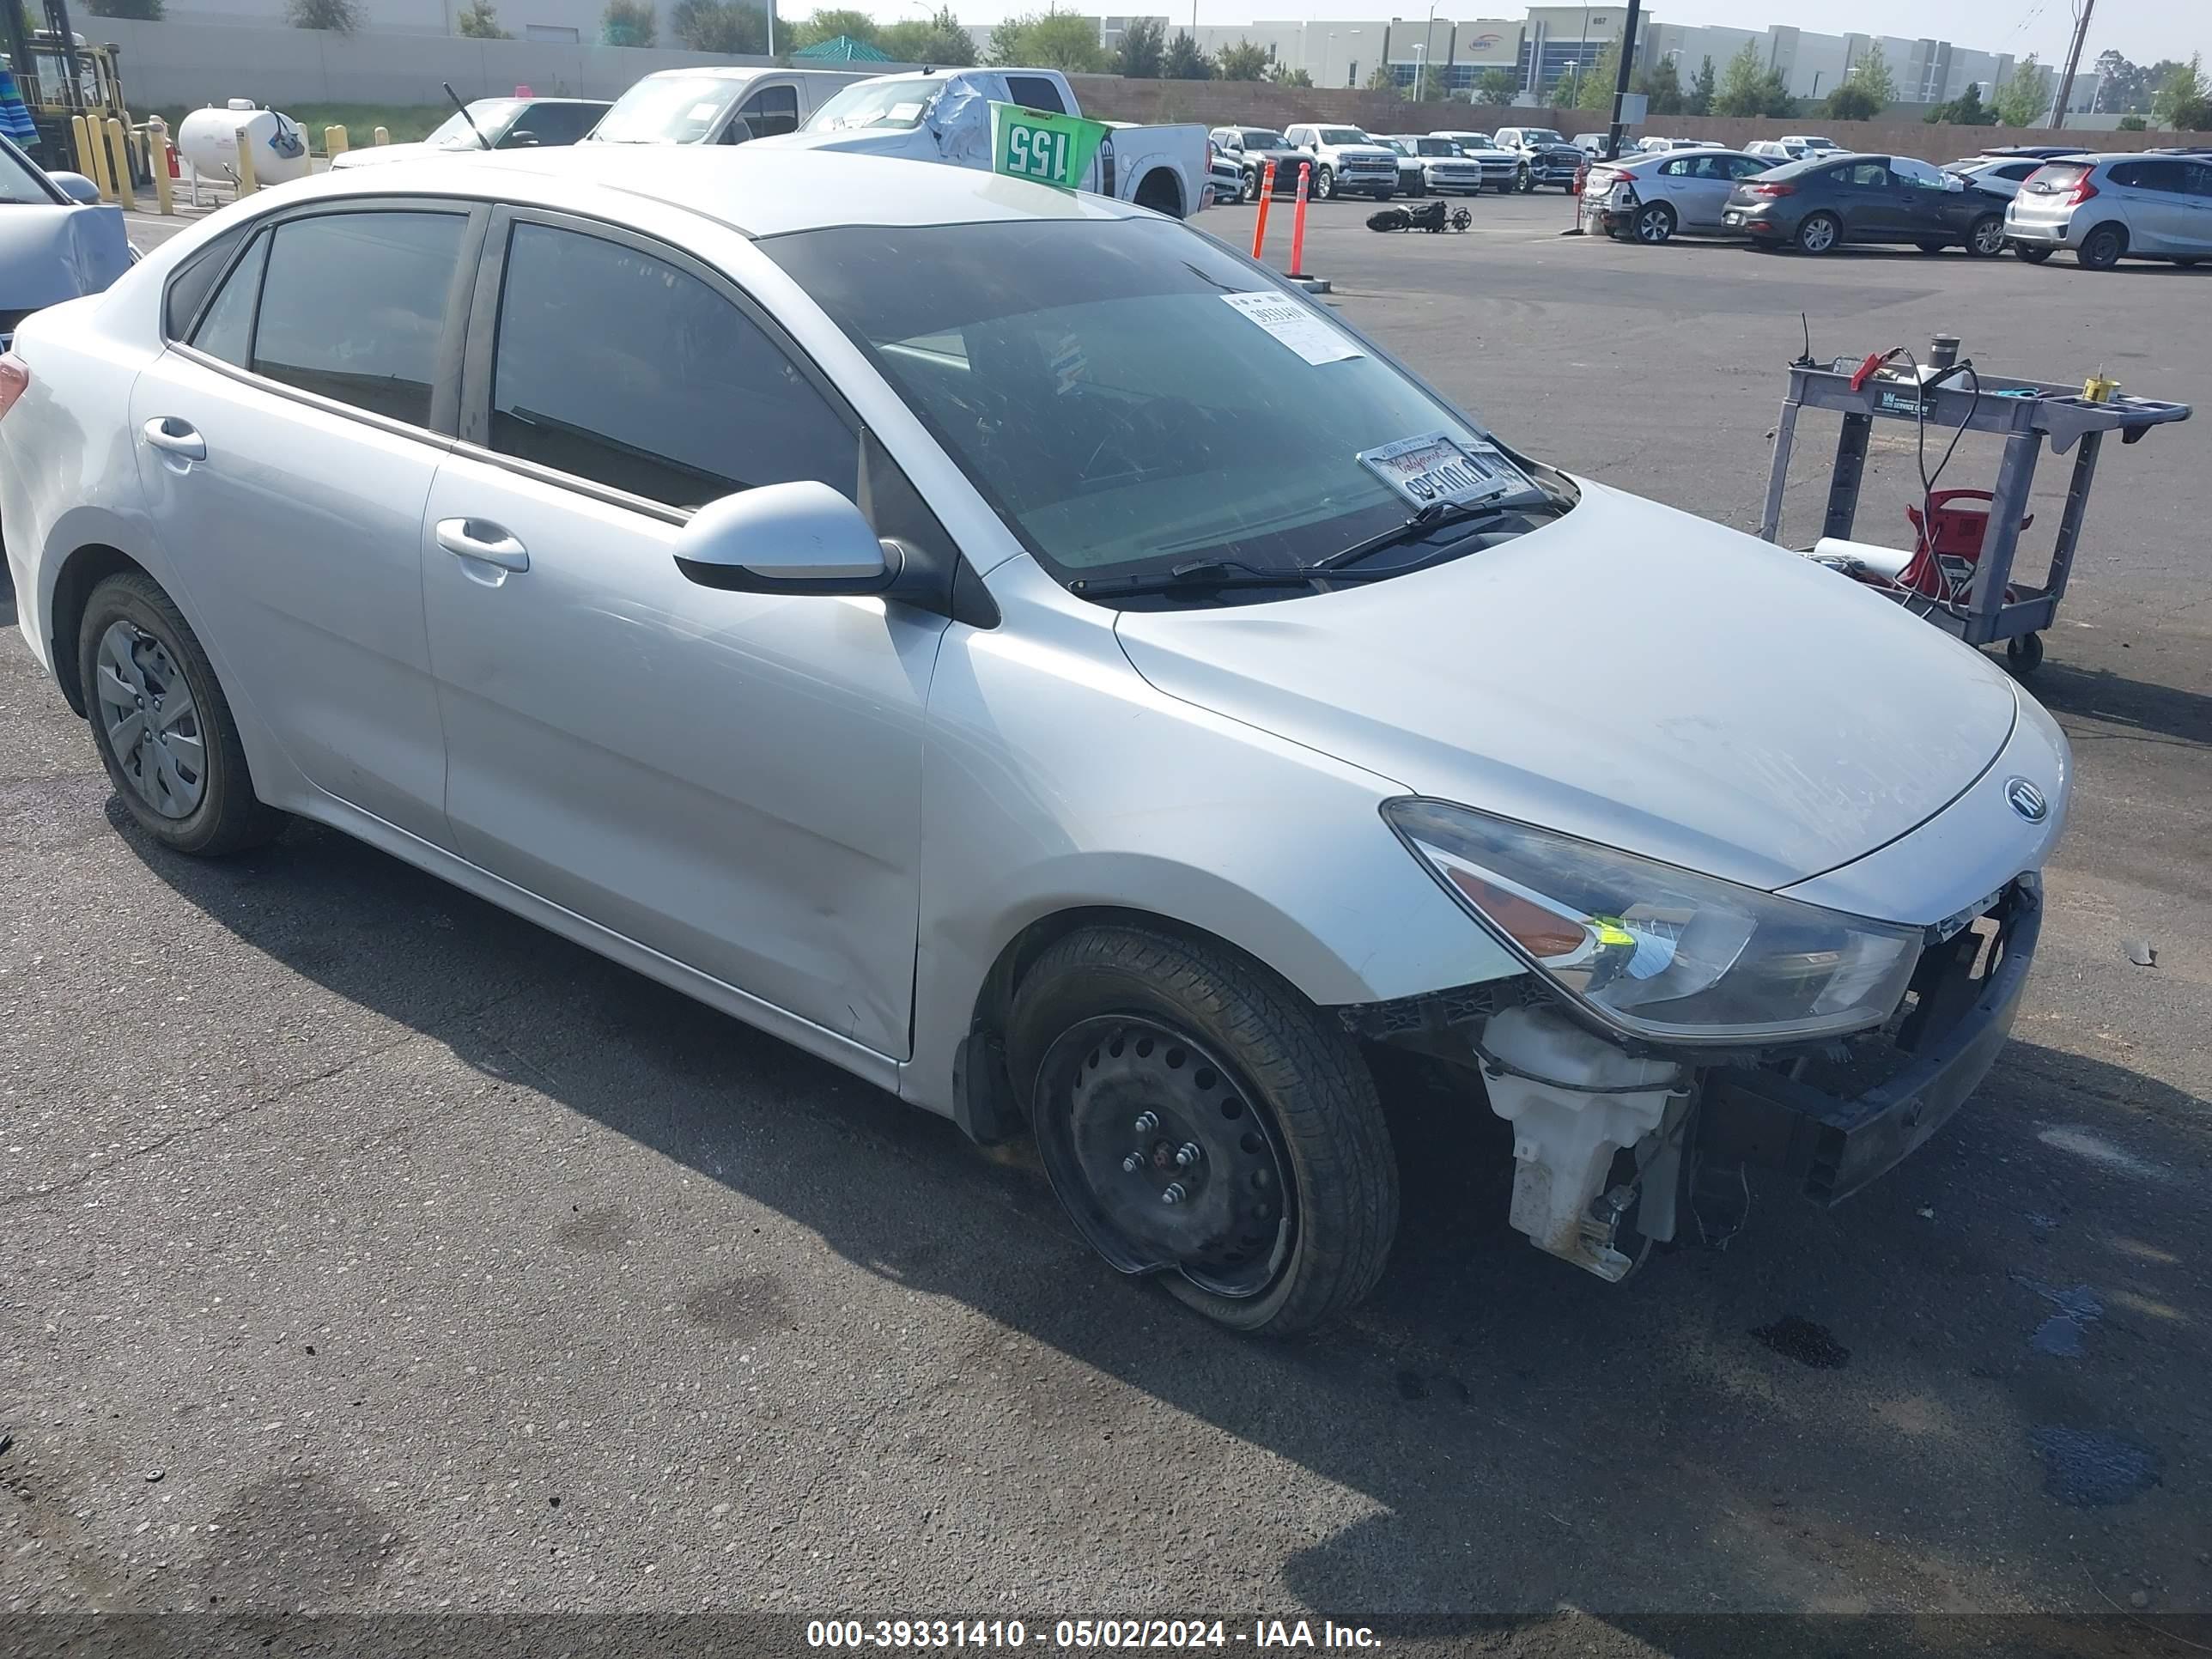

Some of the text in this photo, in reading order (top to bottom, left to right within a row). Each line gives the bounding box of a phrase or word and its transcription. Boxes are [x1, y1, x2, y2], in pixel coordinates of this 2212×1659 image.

[1593, 16, 1607, 25] 657
[1009, 126, 1066, 180] 155
[1250, 307, 1307, 323] 39331410
[1893, 402, 1915, 411] SERVICE
